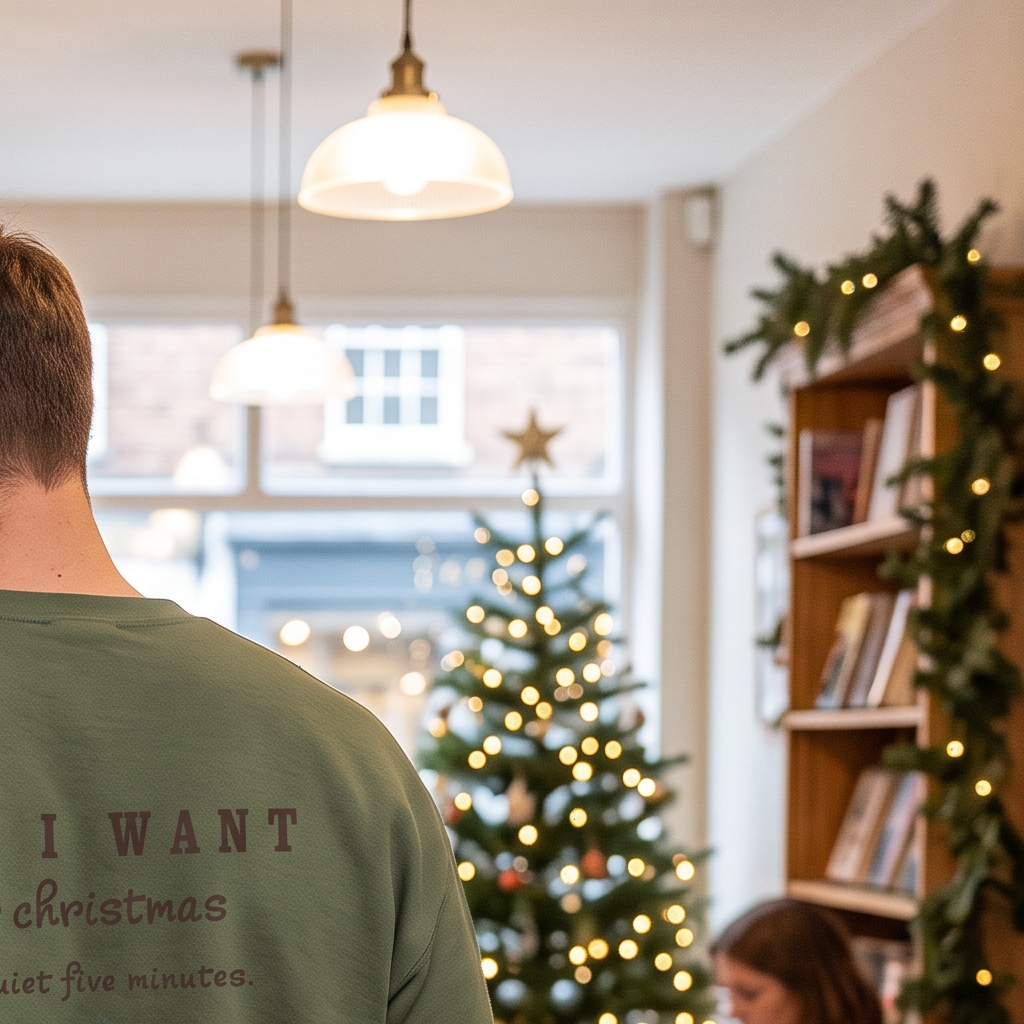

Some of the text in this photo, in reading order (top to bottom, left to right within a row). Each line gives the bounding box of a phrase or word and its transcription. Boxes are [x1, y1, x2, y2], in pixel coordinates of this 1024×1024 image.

[39, 812, 59, 860] I
[107, 807, 298, 857] WANT
[12, 877, 228, 930] christmas
[59, 961, 116, 1002] five
[126, 964, 255, 991] minutes.
